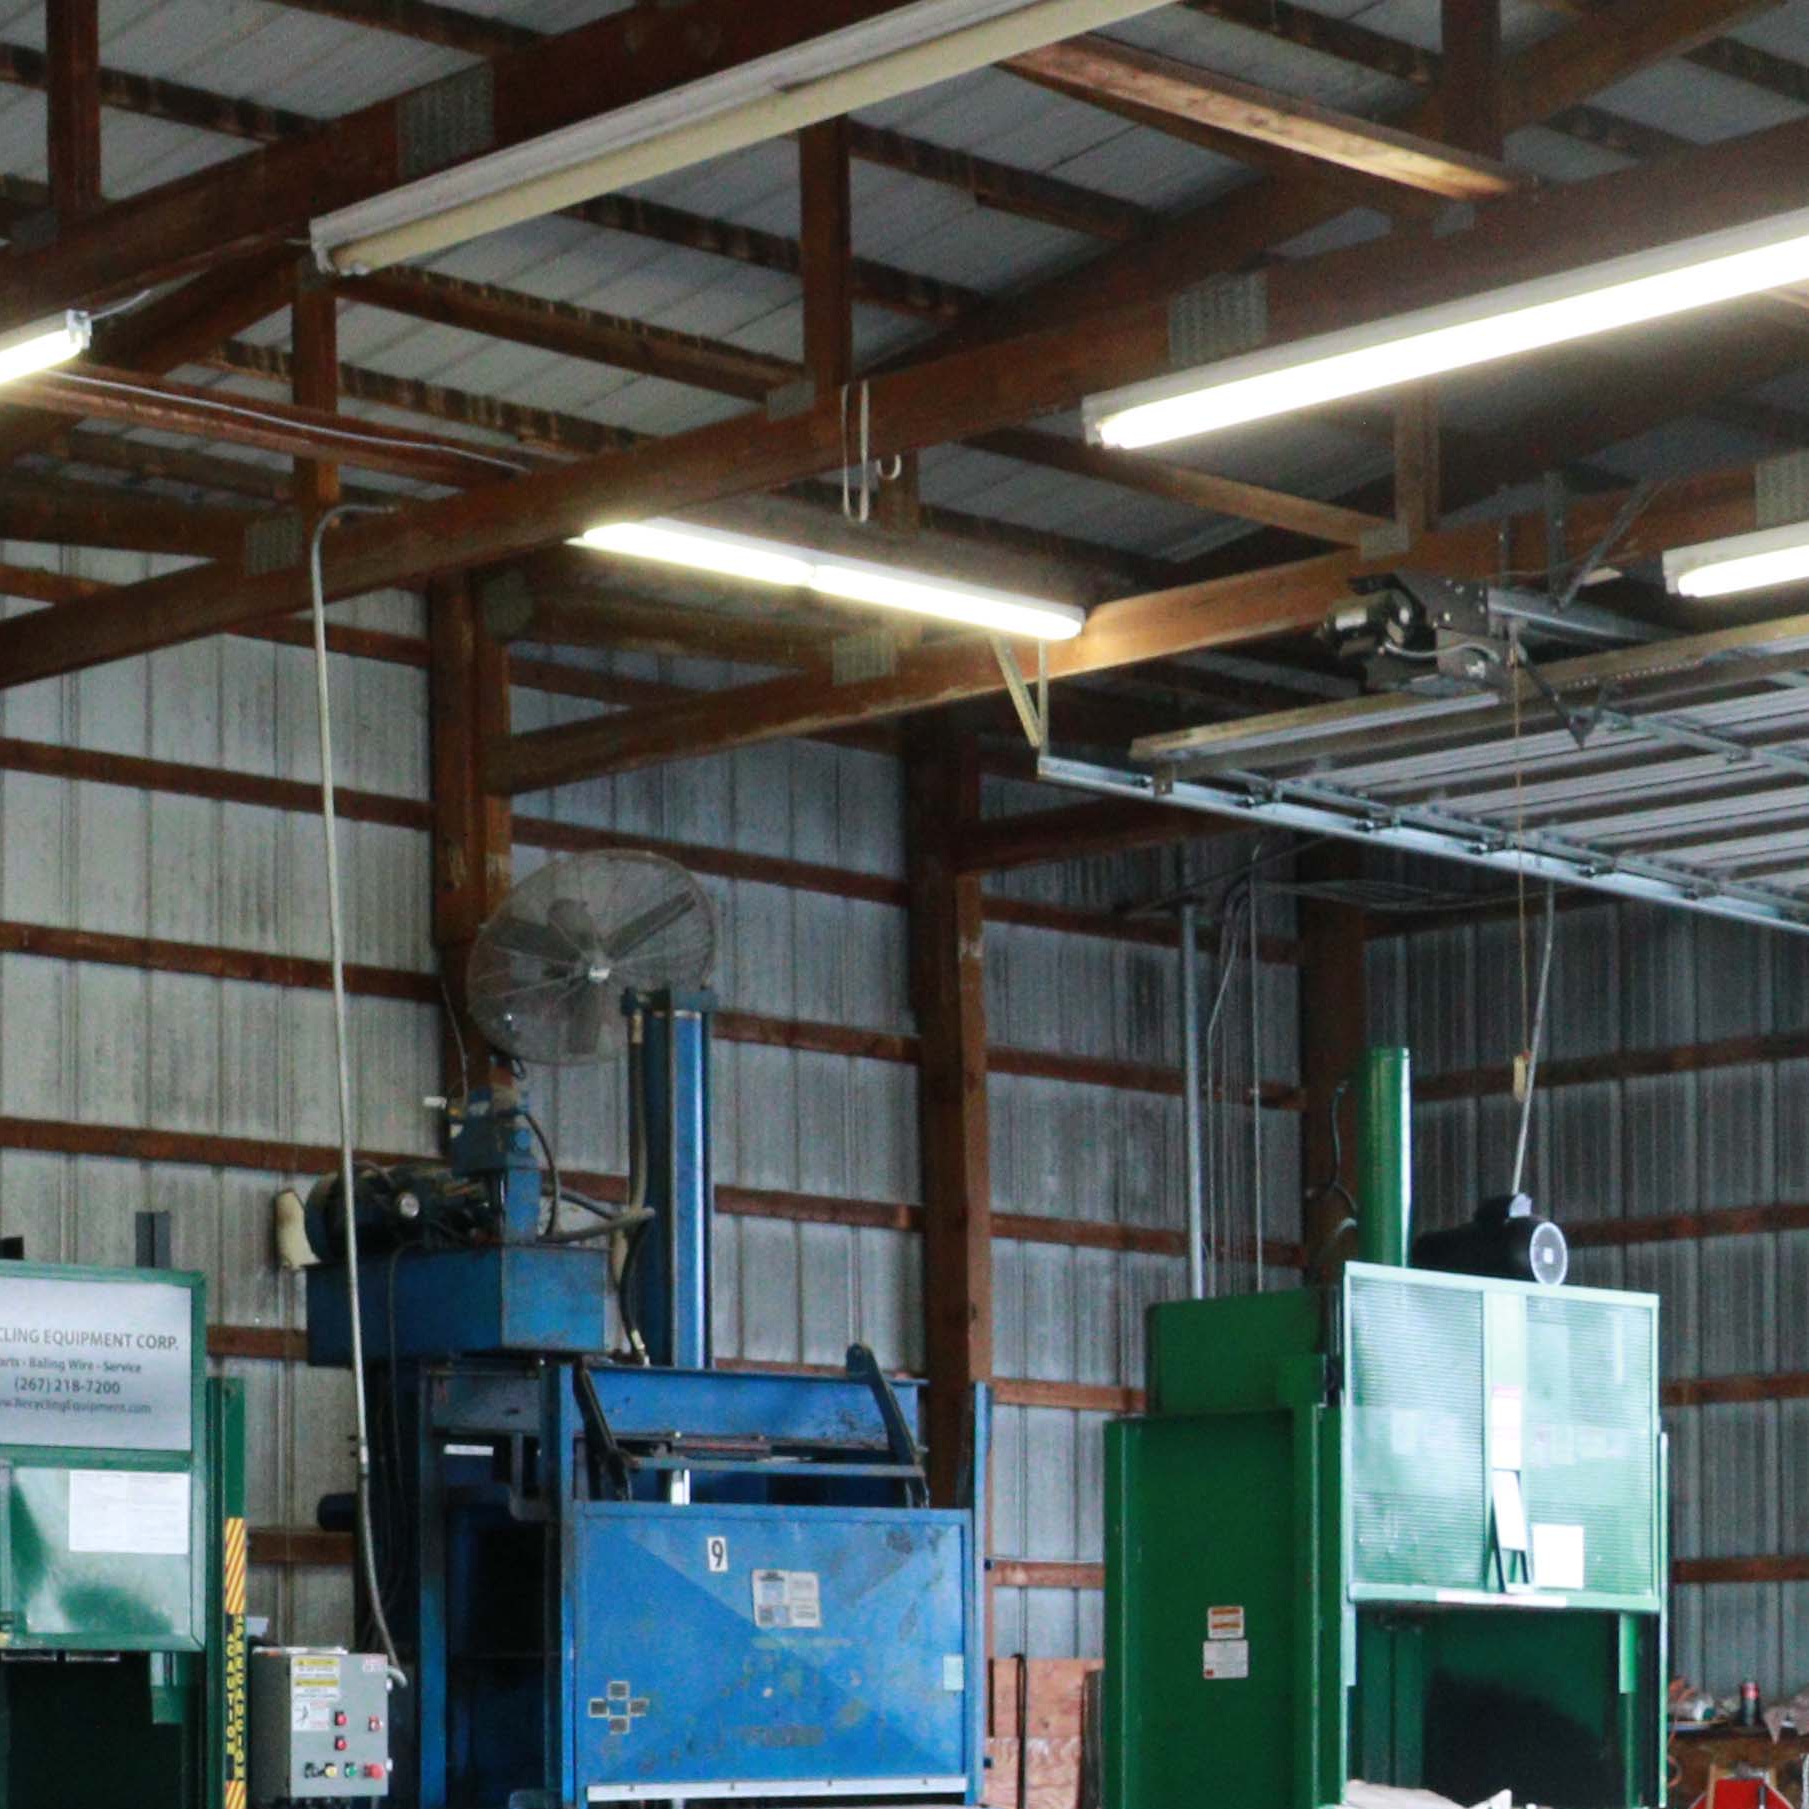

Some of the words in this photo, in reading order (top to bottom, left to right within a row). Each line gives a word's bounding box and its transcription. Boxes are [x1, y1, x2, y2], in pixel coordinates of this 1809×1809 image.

[43, 1329, 133, 1348] EQUIPMENT
[136, 1334, 180, 1350] CORP.
[29, 1357, 66, 1371] Baling
[68, 1358, 94, 1371] Wire
[103, 1361, 142, 1373] Service
[14, 1377, 51, 1393] (267)
[54, 1378, 121, 1394] 218-7200
[711, 1540, 724, 1568] 9
[226, 1642, 236, 1755] CAUTION
